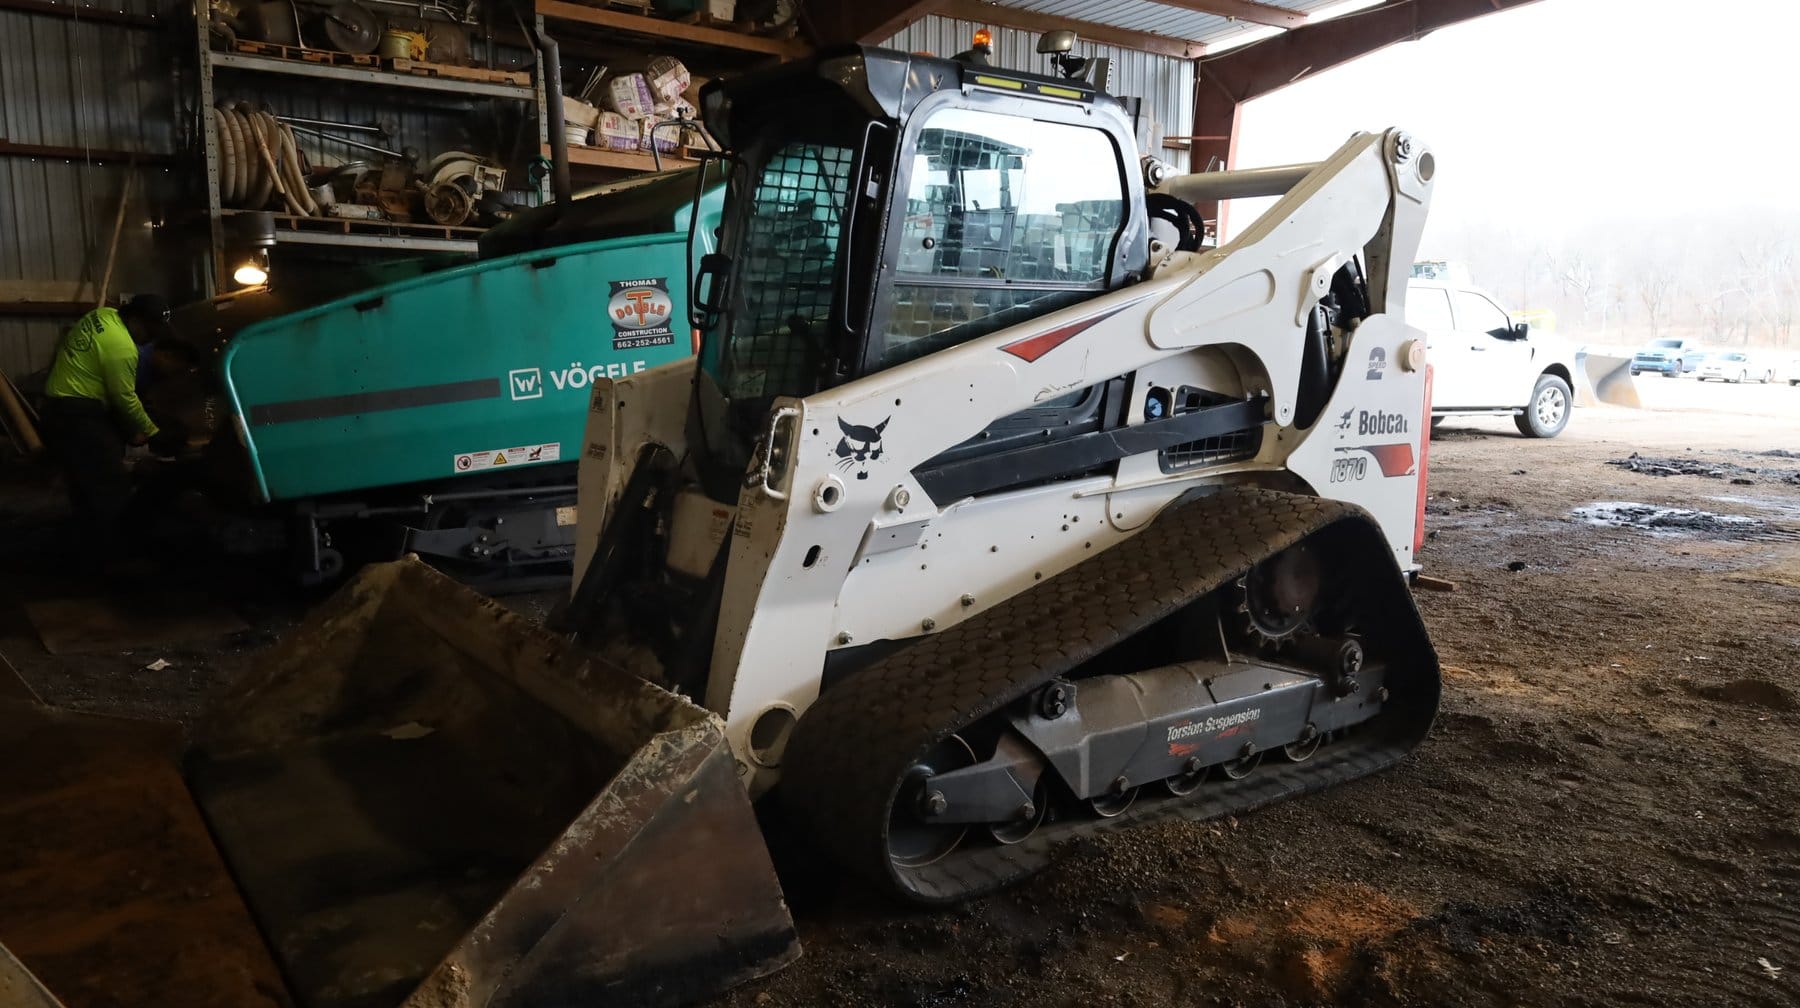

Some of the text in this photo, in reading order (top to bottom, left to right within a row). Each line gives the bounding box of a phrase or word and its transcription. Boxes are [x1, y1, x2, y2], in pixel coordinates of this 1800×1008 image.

[619, 279, 657, 287] THOMAS
[615, 302, 666, 320] DOUBLE
[625, 290, 653, 326] T
[618, 327, 668, 337] CONSTRUCTION
[617, 336, 671, 348] 662-252-4561
[1366, 346, 1386, 381] 2
[1368, 361, 1388, 369] SPEED
[1167, 707, 1261, 742] Torsion Suspension
